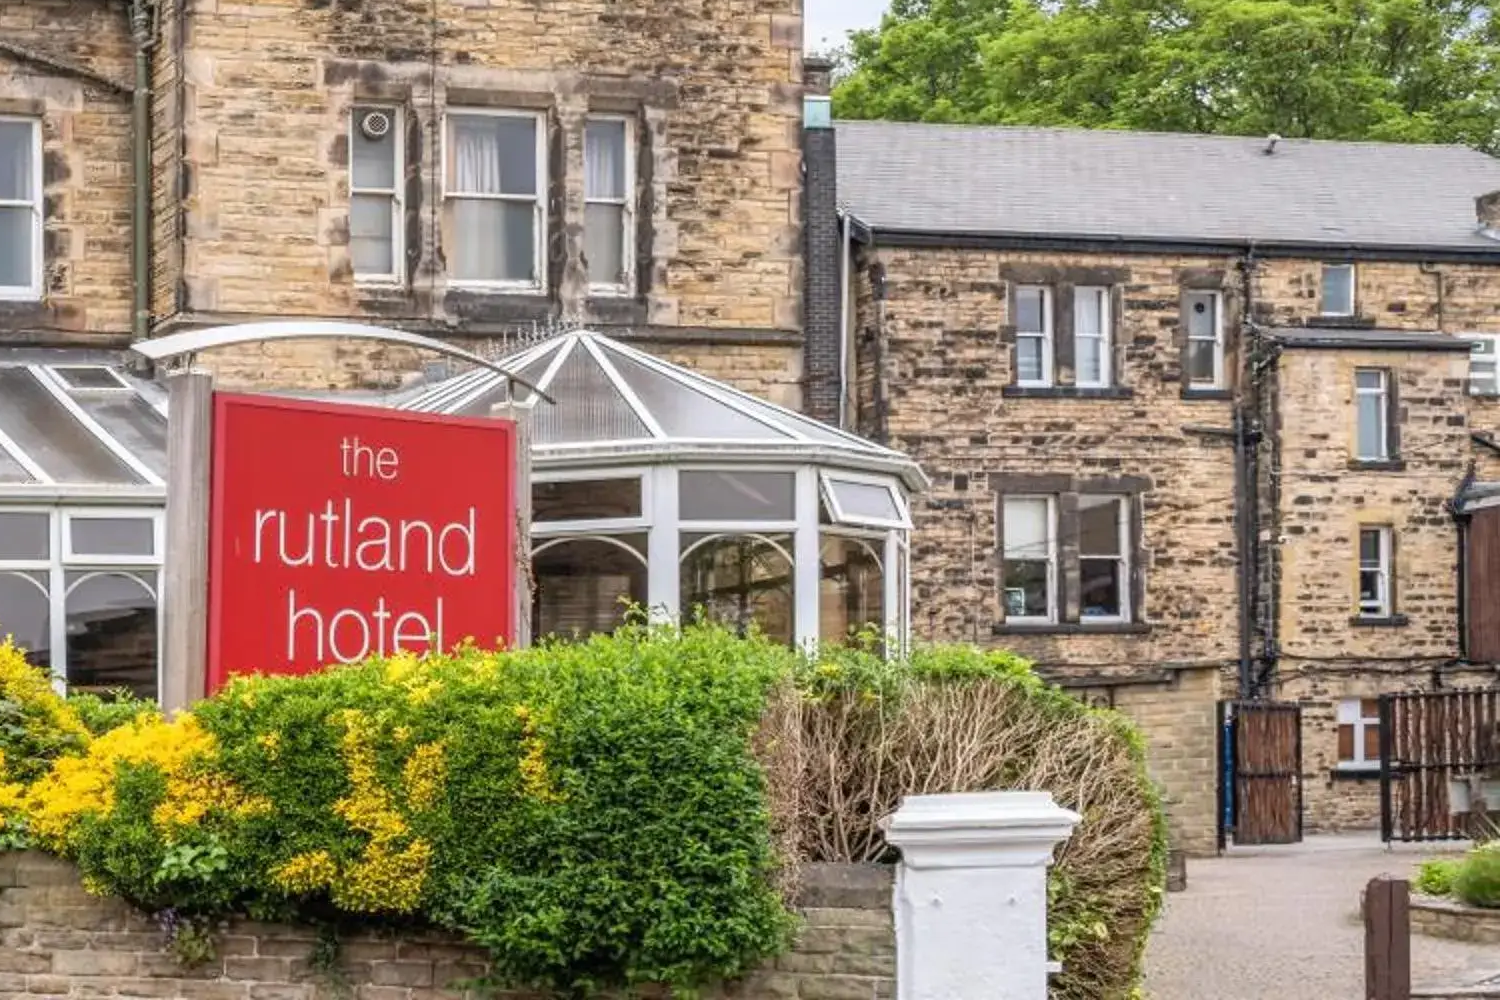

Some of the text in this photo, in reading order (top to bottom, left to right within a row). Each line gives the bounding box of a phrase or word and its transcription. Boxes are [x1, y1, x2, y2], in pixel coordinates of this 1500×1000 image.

[340, 436, 399, 479] the
[254, 498, 475, 576] rutland
[288, 589, 443, 664] hotel
